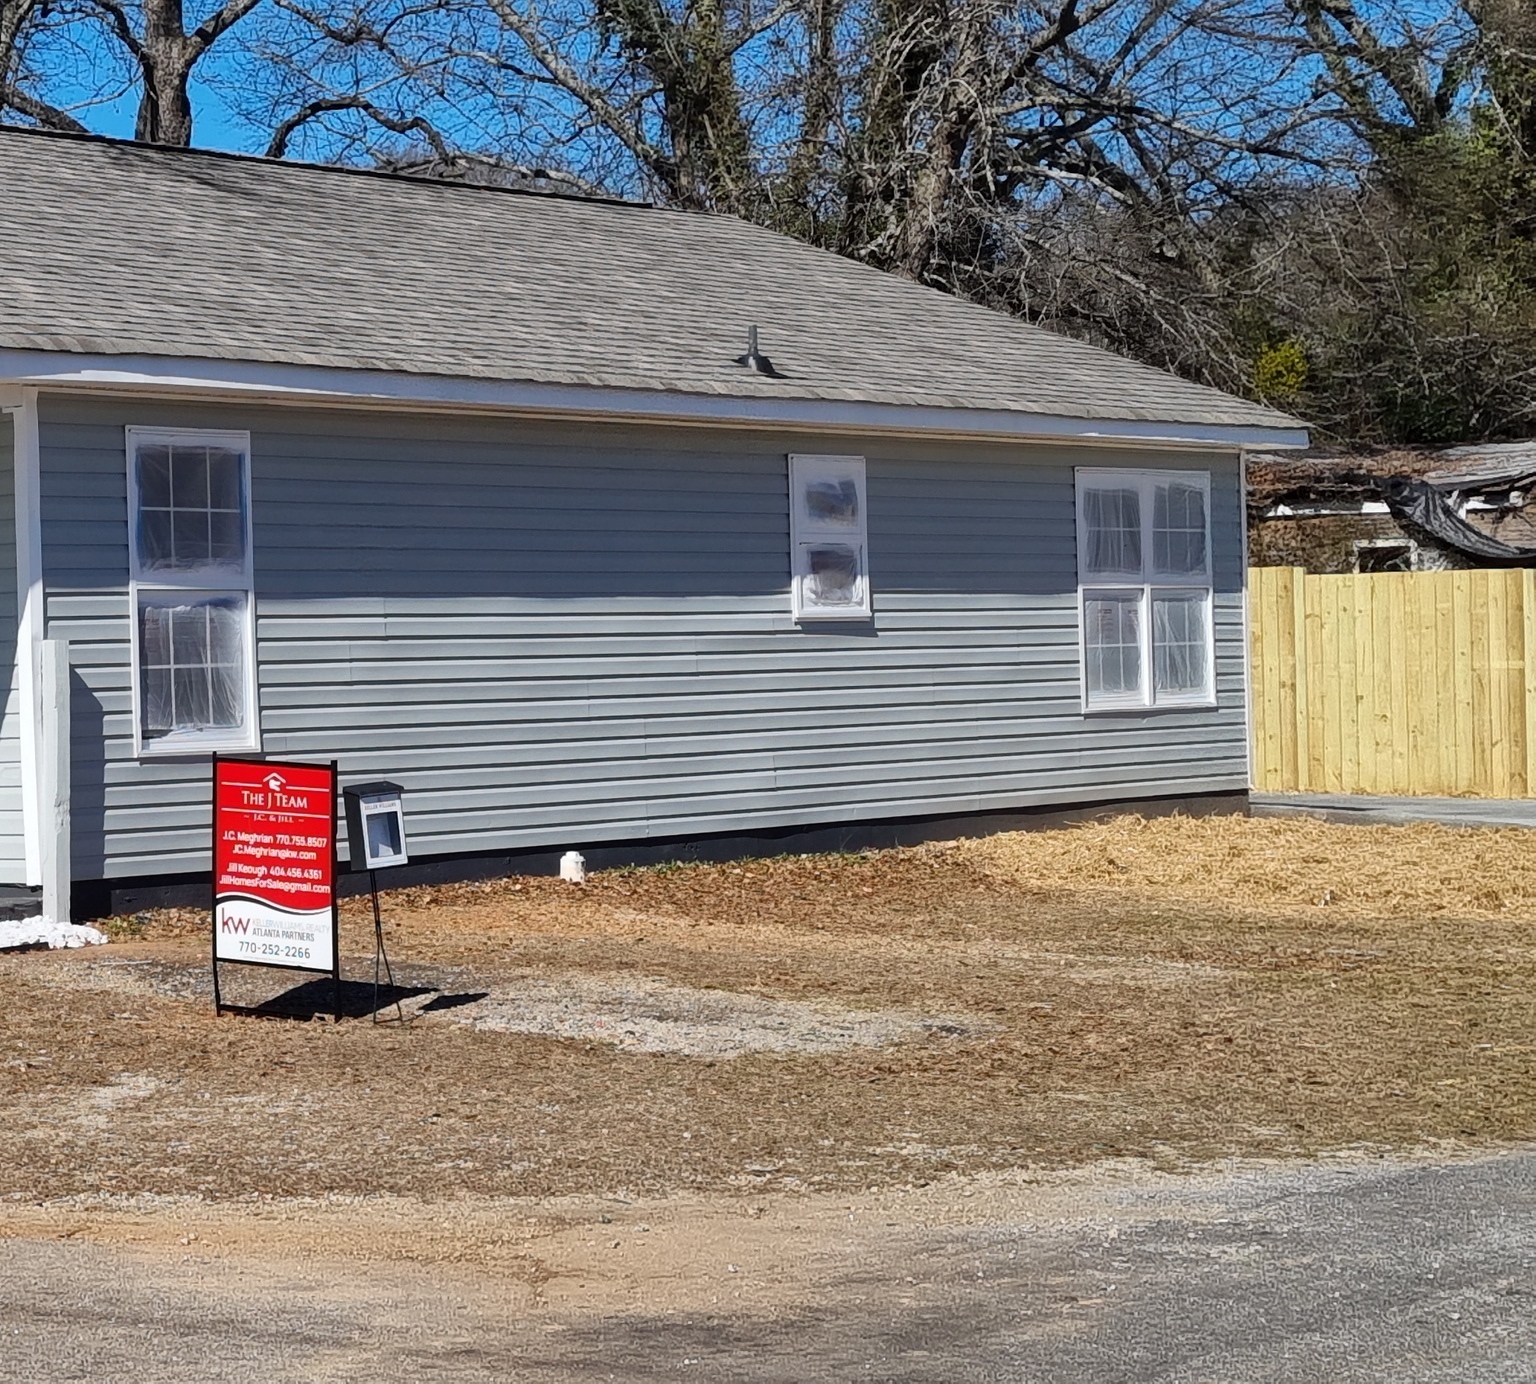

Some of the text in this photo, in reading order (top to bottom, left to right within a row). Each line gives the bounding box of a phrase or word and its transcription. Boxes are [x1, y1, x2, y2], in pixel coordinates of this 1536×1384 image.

[241, 790, 308, 809] THE J TEAM
[269, 814, 276, 822] &
[278, 815, 294, 823] JILL
[223, 830, 327, 848] J.C. Meghrian 770.755.8507
[232, 844, 317, 859] JC.Meghrian@kw.com
[227, 862, 323, 880] Jill Keough 404.456.4361
[219, 875, 331, 893] JillHomesForSale@gmail.com
[222, 907, 250, 935] kw
[252, 927, 315, 942] ATLANTA PARTNERS
[239, 941, 311, 959] 770-252-2266
